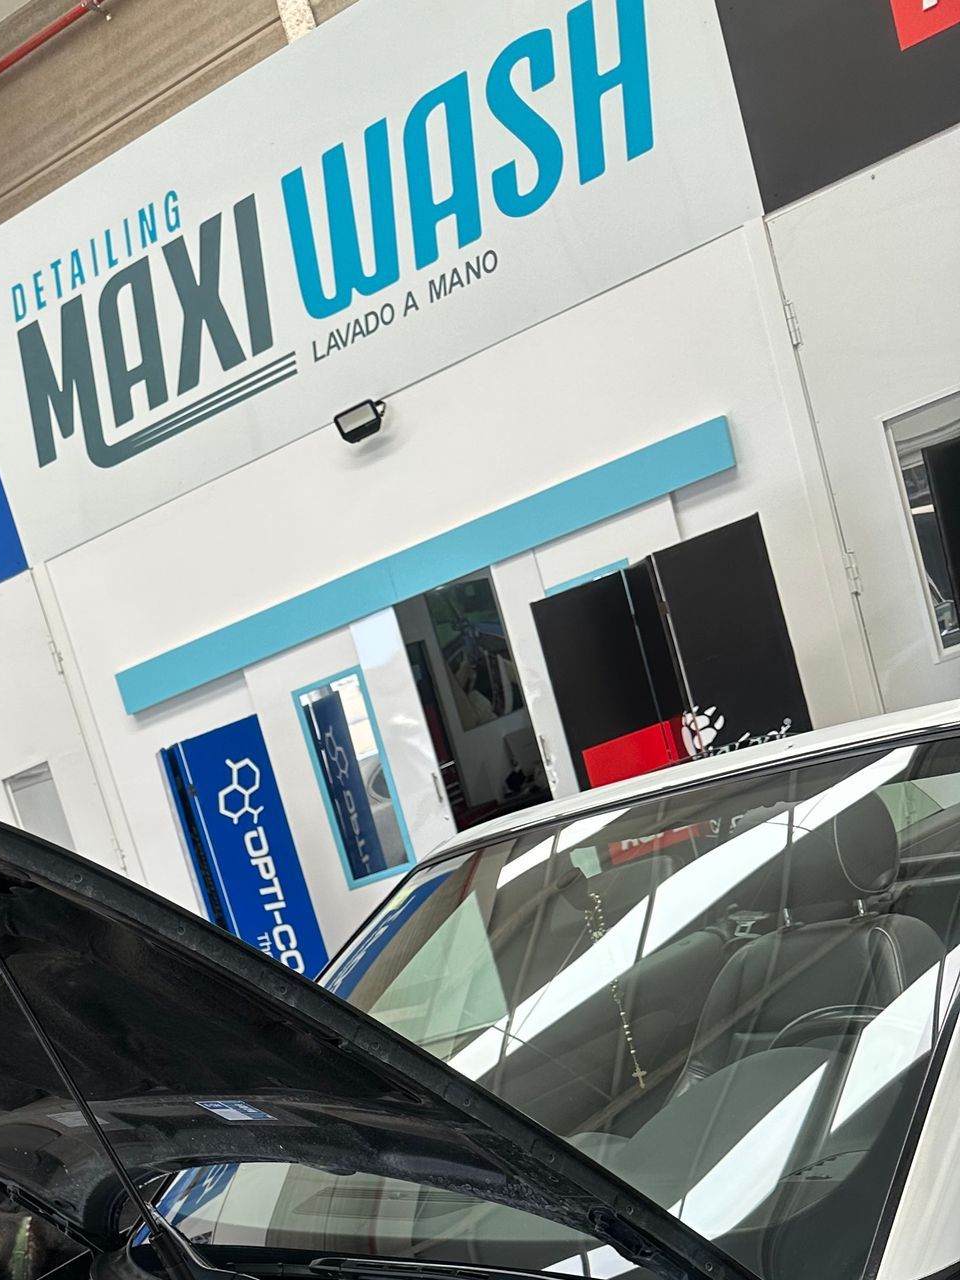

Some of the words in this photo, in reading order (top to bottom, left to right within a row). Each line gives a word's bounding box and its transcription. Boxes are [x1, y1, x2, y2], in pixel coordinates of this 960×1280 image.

[11, 190, 181, 323] DETAILING
[16, 193, 274, 469] MAXI
[281, 0, 654, 320] WASH
[312, 303, 396, 363] LAVADO
[403, 290, 420, 317] A
[428, 249, 498, 304] MANO
